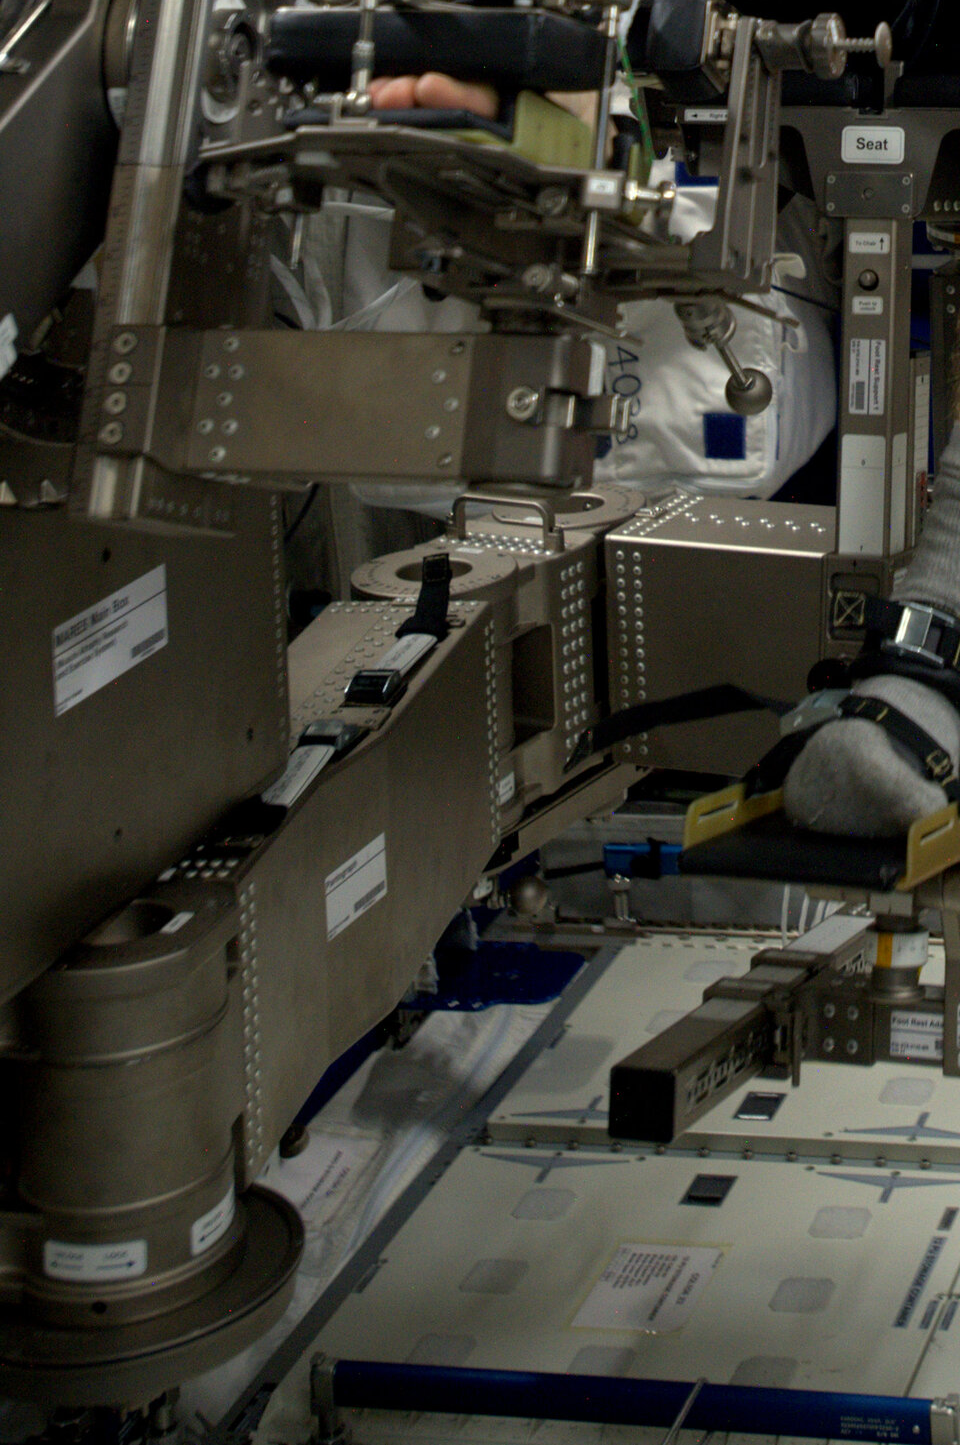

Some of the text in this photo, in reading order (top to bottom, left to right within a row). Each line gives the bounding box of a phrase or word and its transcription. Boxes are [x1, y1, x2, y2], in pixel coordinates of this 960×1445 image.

[856, 137, 889, 151] Seat
[892, 1016, 910, 1026] Foot
[910, 1018, 929, 1027] Rest
